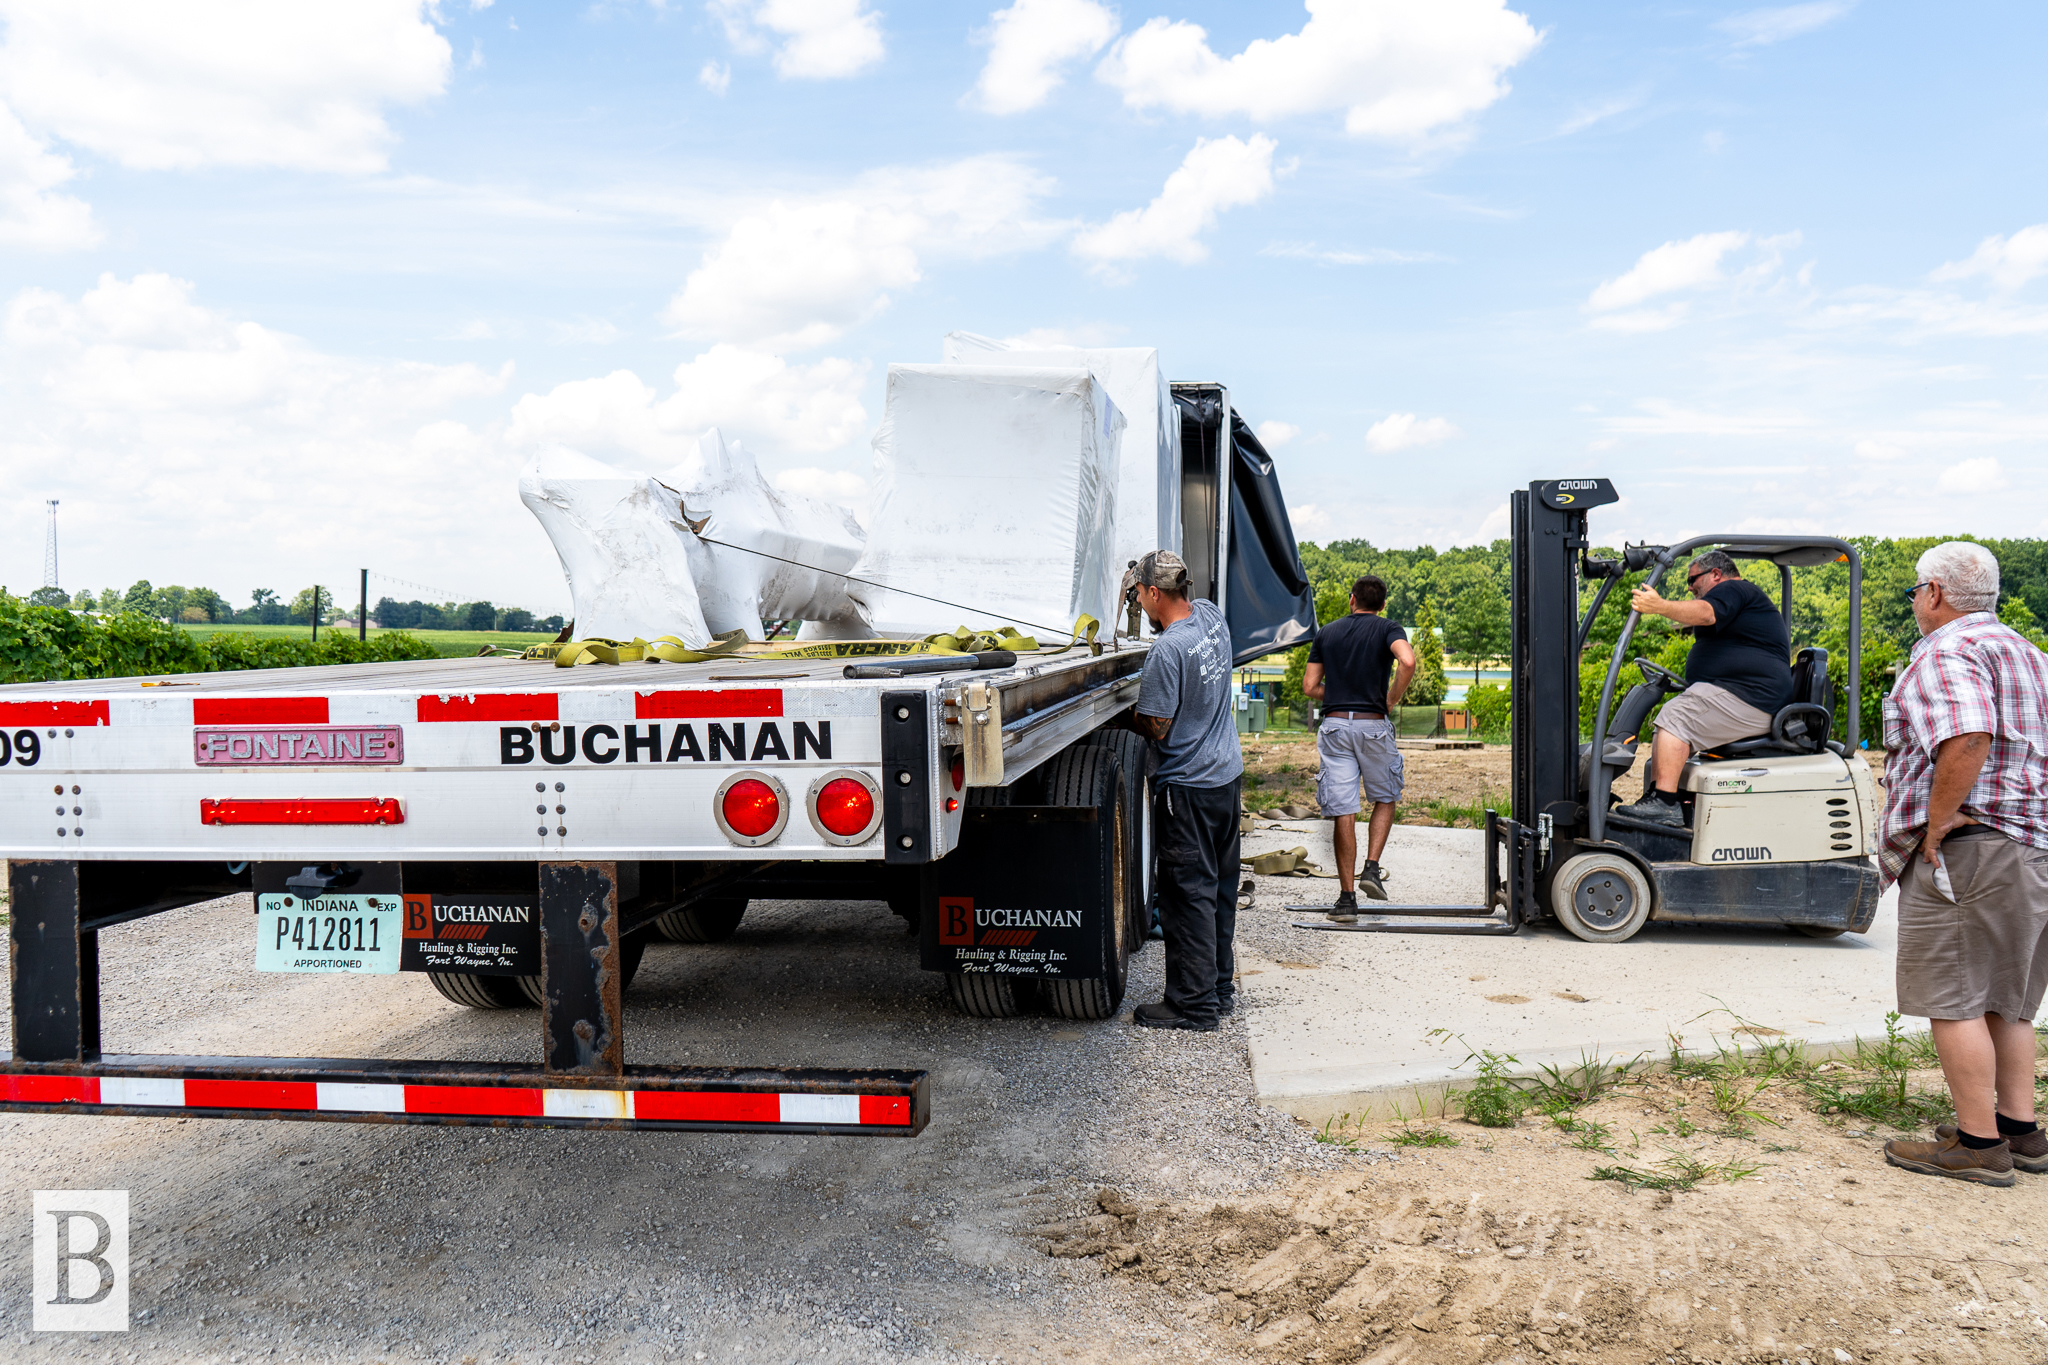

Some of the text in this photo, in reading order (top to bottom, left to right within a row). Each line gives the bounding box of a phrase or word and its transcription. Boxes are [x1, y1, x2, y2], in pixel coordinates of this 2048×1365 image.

[1558, 479, 1598, 490] CROWN
[207, 733, 387, 759] FONTAINE
[500, 721, 832, 765] BUCHANAN
[1712, 847, 1772, 861] CROWN
[266, 899, 397, 912] NO INDIANA EXP
[406, 901, 530, 931] BUCHANAN
[945, 904, 1082, 936] BUCHANAN
[276, 916, 381, 952] P412811
[419, 941, 518, 956] Hauling & Rigging Inc.
[955, 948, 1068, 963] Hauling & Rigging Inc.
[293, 959, 362, 969] APPORTIONED
[425, 954, 451, 966] Fort
[497, 956, 514, 966] In.
[961, 962, 990, 974] Fort
[1043, 963, 1061, 974] In.
